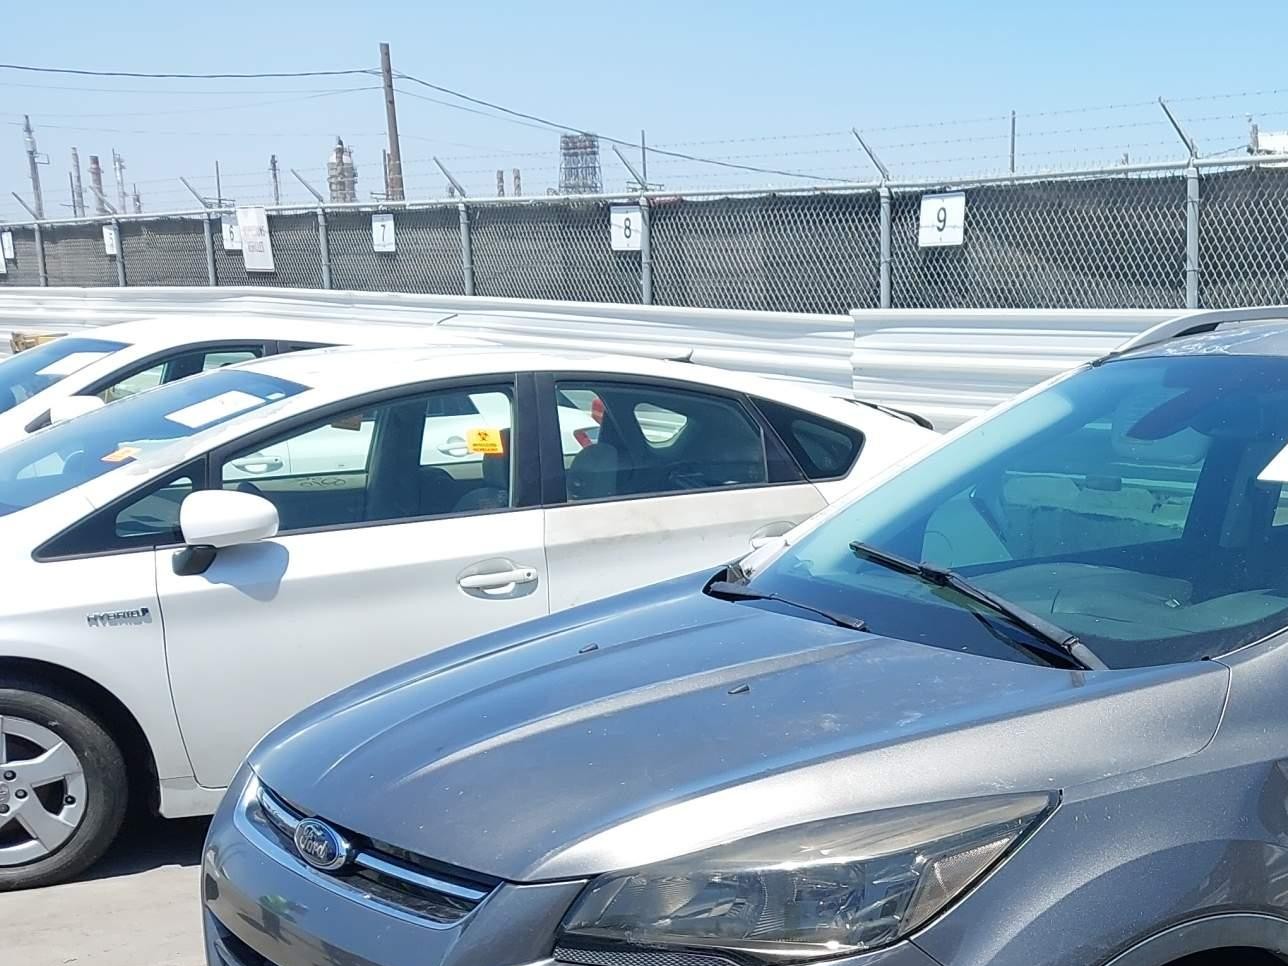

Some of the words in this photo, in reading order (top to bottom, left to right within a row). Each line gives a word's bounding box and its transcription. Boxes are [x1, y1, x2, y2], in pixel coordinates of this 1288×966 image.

[624, 217, 631, 239] 8
[937, 207, 947, 232] 9
[229, 224, 235, 241] 6
[380, 224, 386, 242] 7
[300, 825, 328, 859] Ford
